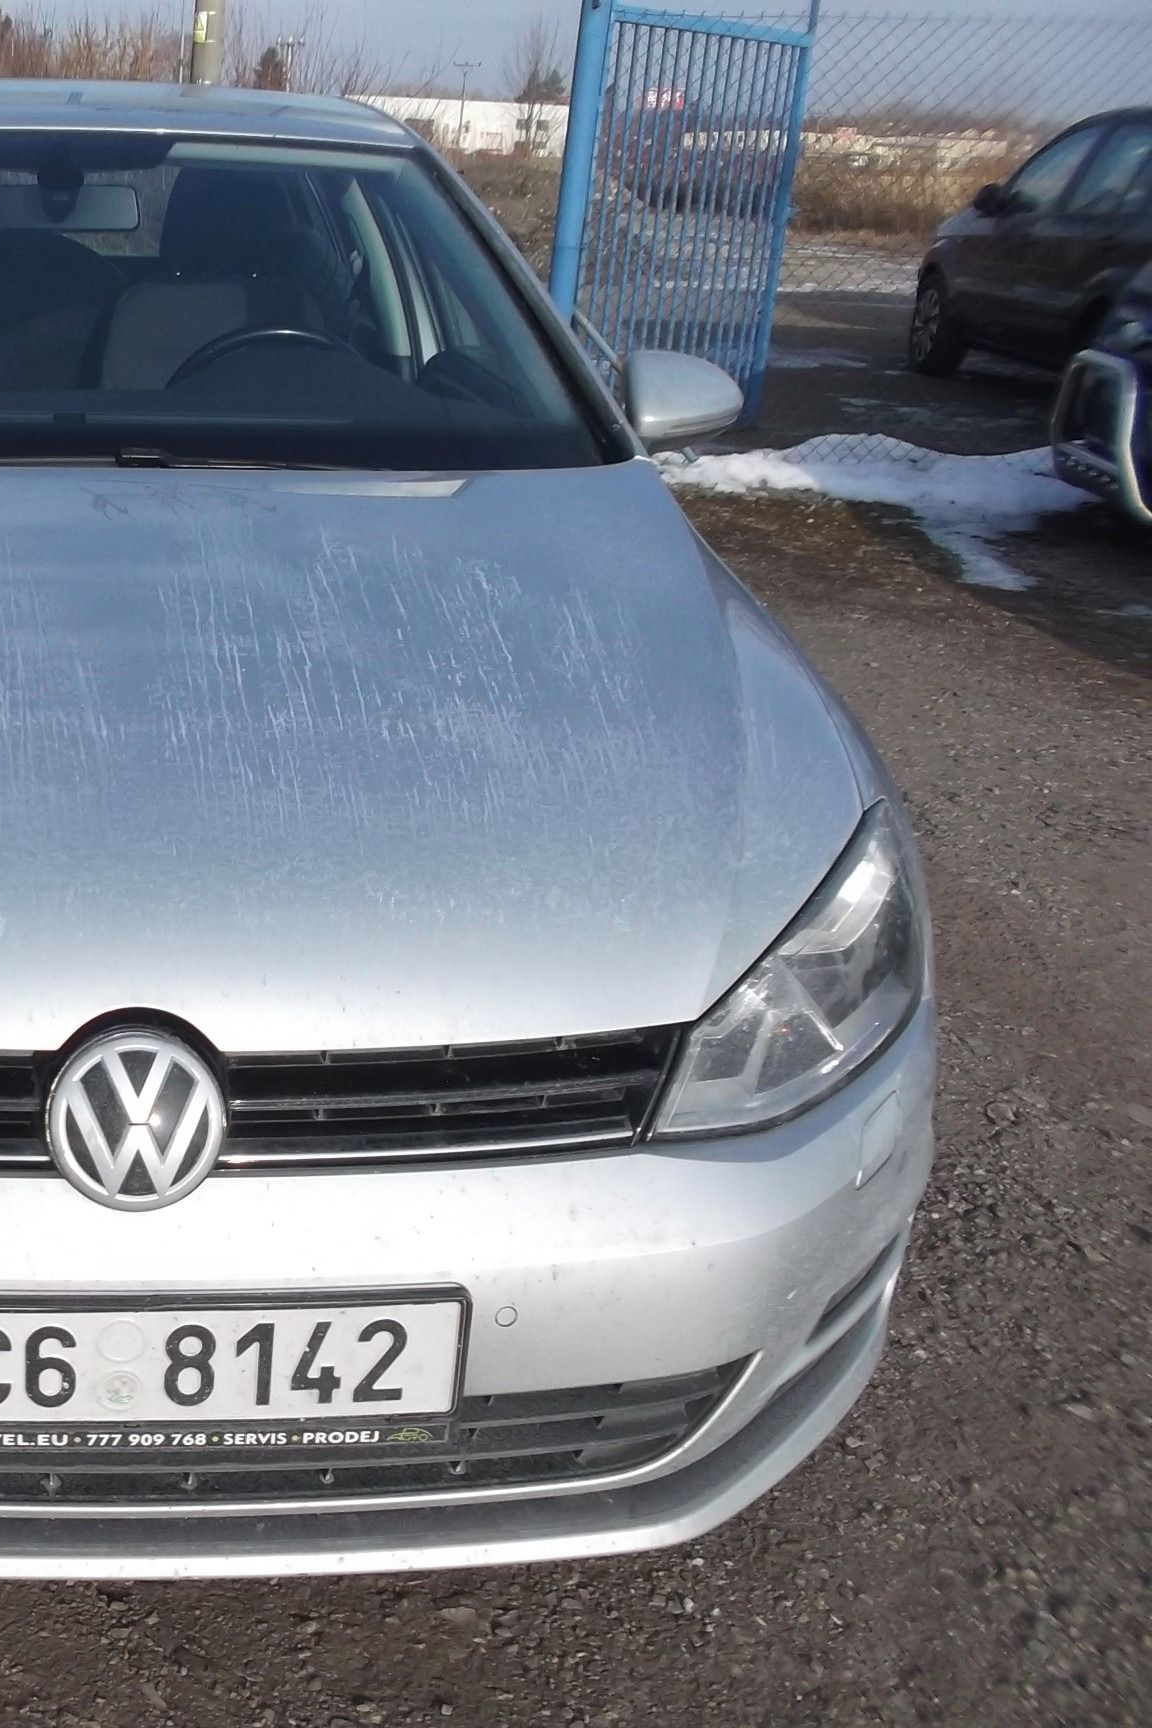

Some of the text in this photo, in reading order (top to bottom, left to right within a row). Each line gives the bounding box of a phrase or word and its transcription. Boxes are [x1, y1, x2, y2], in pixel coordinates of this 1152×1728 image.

[55, 1044, 217, 1205] VW
[163, 1317, 409, 1408] 8142
[86, 1433, 123, 1447] 777
[127, 1433, 166, 1447] 909
[170, 1433, 208, 1447] 768
[223, 1432, 288, 1446] SERVIS
[302, 1430, 381, 1444] PRODEJ
